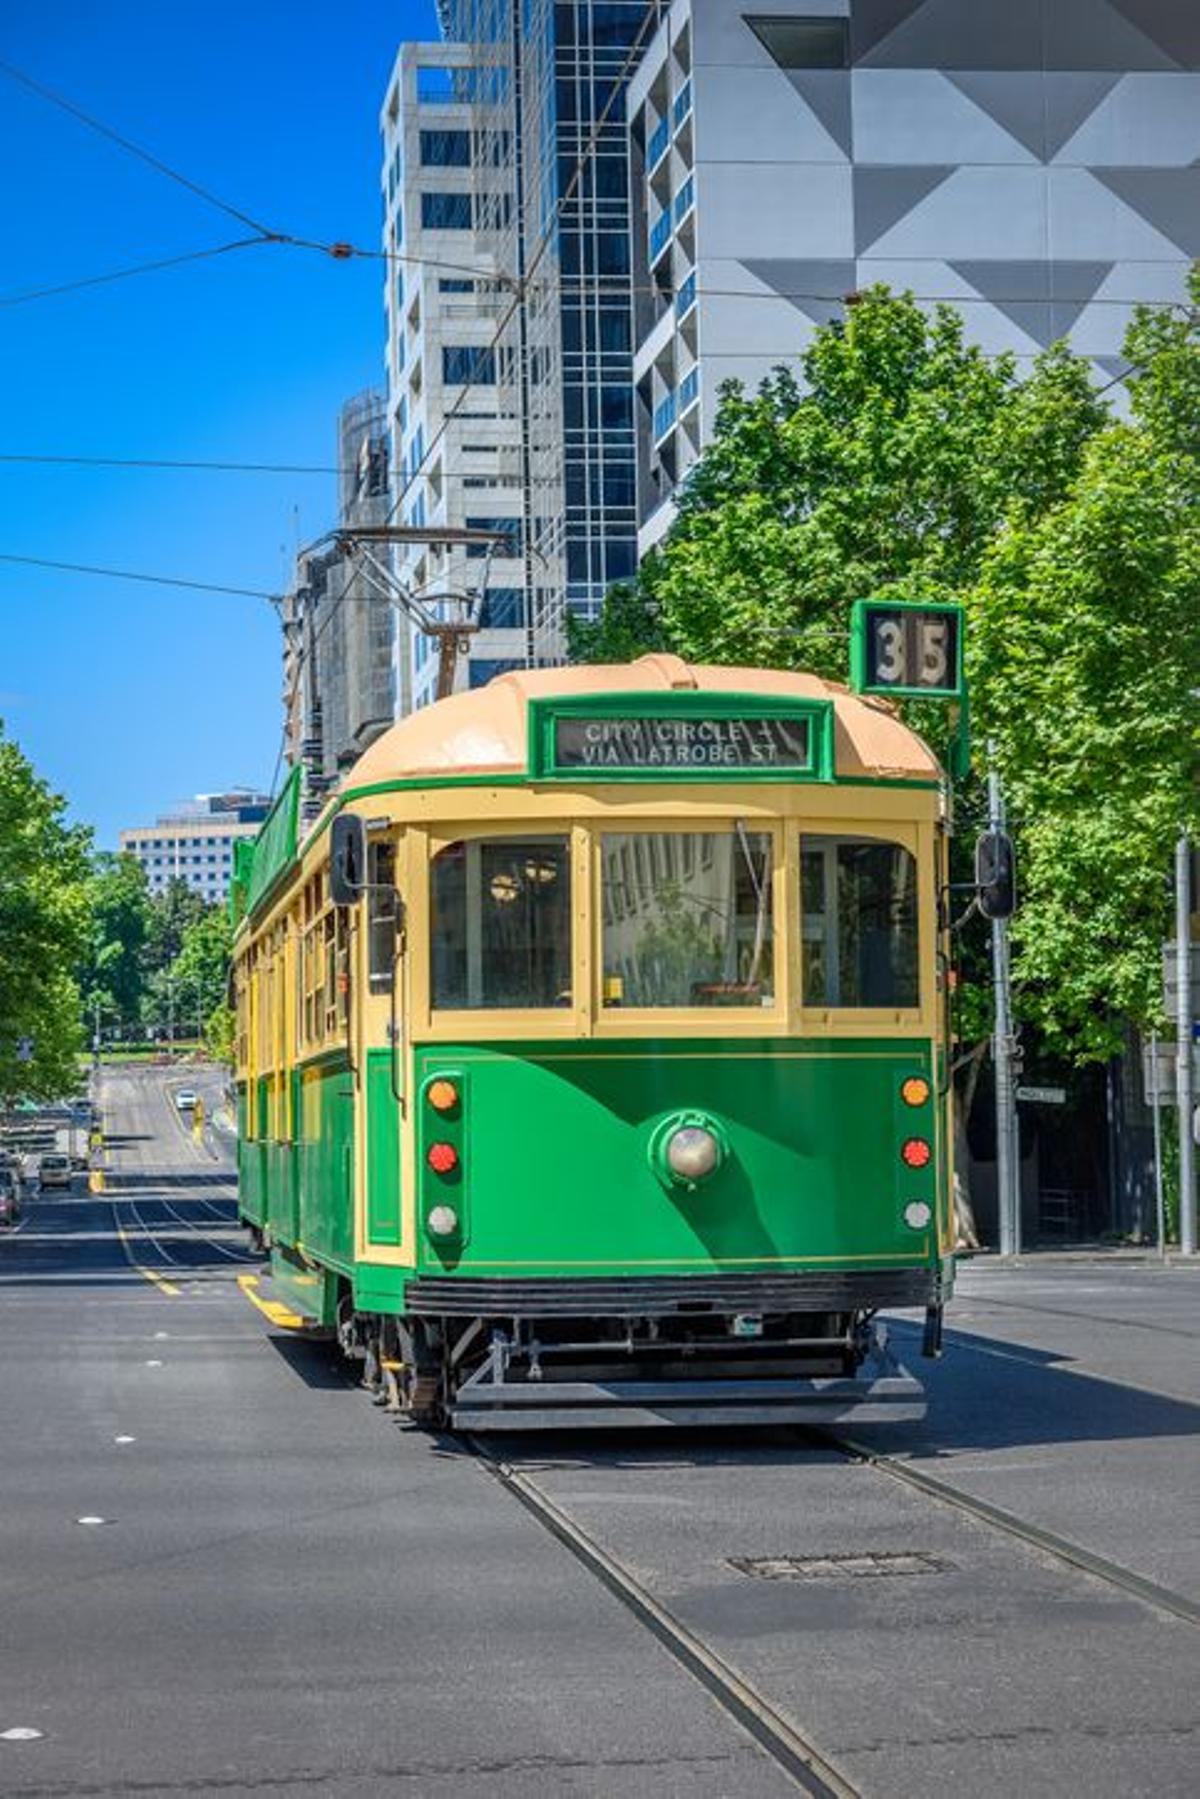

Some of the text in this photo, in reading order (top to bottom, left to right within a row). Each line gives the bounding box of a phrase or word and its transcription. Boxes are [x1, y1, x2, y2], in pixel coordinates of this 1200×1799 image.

[877, 621, 947, 683] 35
[585, 723, 743, 742] CITY CIRCLE
[582, 745, 777, 763] VIA LATROBE ST
